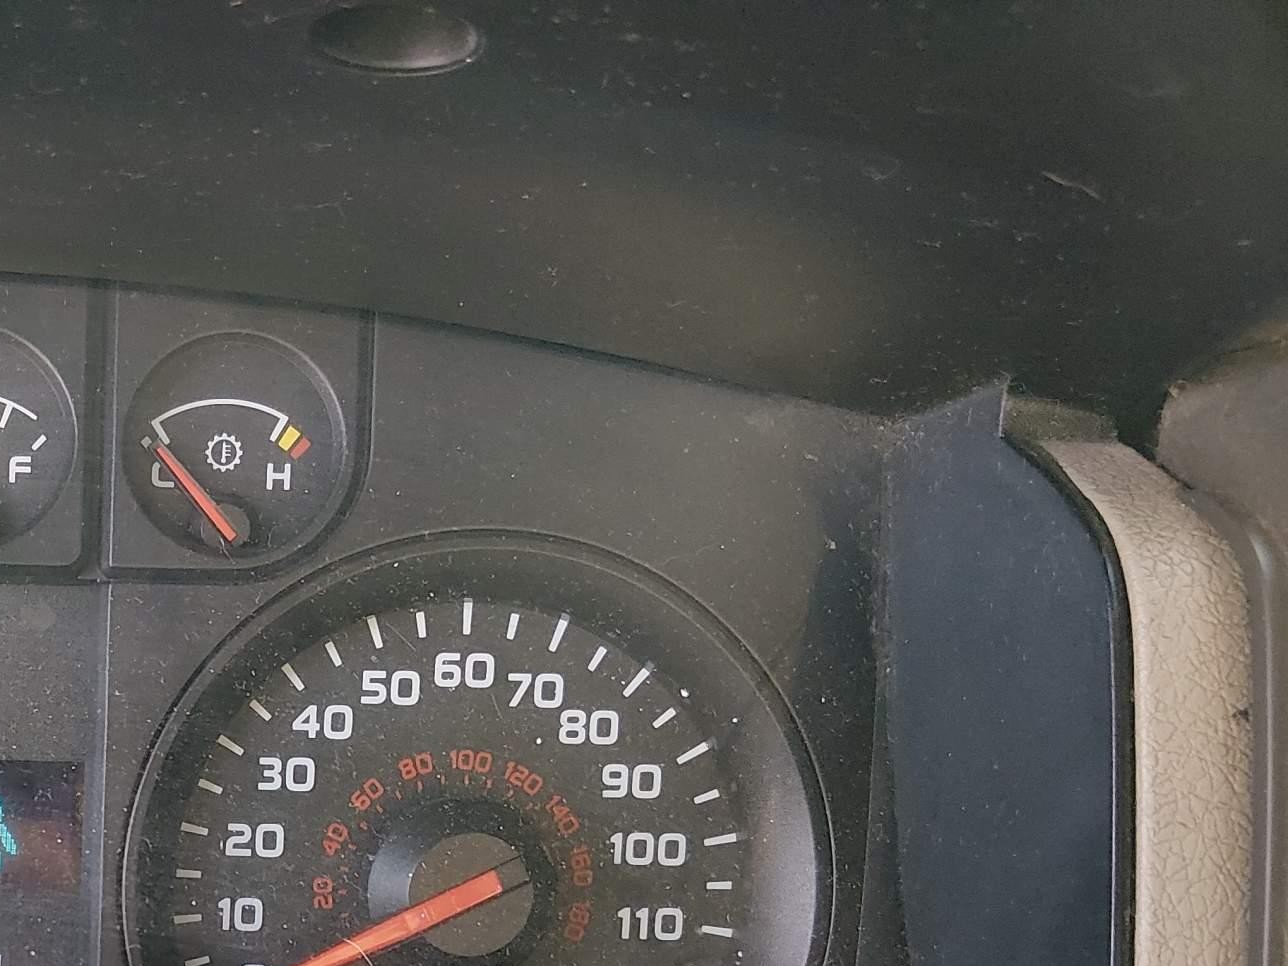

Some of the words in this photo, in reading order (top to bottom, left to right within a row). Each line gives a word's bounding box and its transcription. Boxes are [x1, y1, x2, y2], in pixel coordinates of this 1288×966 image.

[9, 456, 31, 483] F
[267, 463, 290, 490] H
[434, 653, 494, 688] 60
[361, 671, 420, 705] 50
[508, 673, 563, 708] 70
[293, 705, 353, 739] 40
[558, 709, 619, 745] 80
[258, 757, 315, 791] 30
[397, 752, 433, 781] 80
[449, 750, 493, 773] 100
[504, 760, 543, 796] 120
[602, 764, 661, 798] 90
[546, 795, 579, 835] 140
[226, 824, 284, 857] 20
[611, 831, 686, 866] 100
[218, 898, 263, 931] 10
[618, 907, 683, 940] 110
